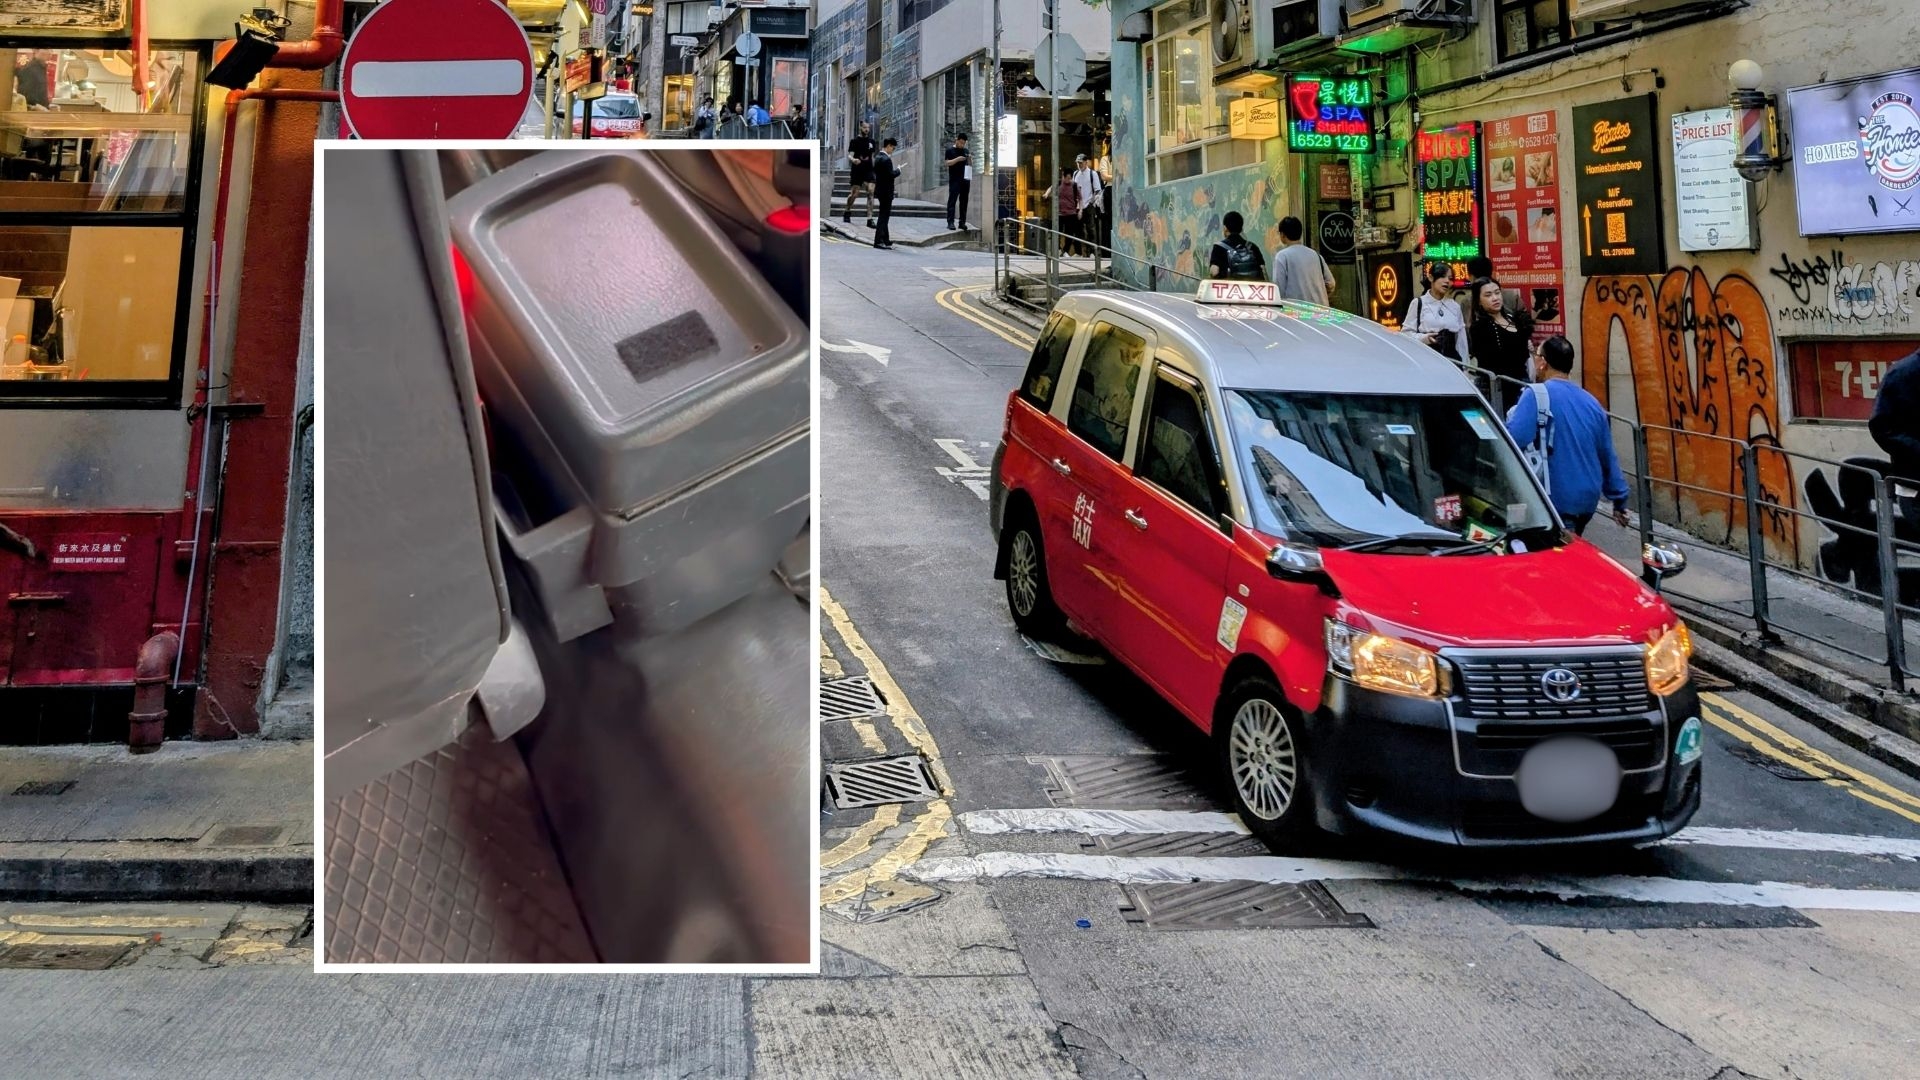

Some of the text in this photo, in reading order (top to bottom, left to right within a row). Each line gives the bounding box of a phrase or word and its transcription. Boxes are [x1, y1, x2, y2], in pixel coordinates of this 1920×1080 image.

[1875, 95, 1888, 106] EST
[1321, 107, 1364, 120] SPA
[1871, 115, 1885, 124] THE
[1297, 120, 1367, 133] 1/F Starlight
[1682, 123, 1733, 139] PRICE LIST
[1298, 135, 1368, 147] 6529 1276
[1420, 134, 1470, 161] Bliss
[1526, 134, 1557, 147] 6529 1276
[1867, 124, 1920, 166] Homie
[1806, 142, 1857, 162] HOMIES
[1426, 158, 1470, 189] SPA
[1586, 160, 1642, 175] Homiesbarbershop
[1597, 198, 1633, 209] Reservation
[1325, 227, 1354, 238] RAW
[1380, 279, 1395, 290] RAW
[1496, 271, 1557, 285] Professional massage
[1212, 283, 1274, 300] TAXI
[1075, 492, 1096, 524] 的士
[1072, 514, 1092, 549] TAXI
